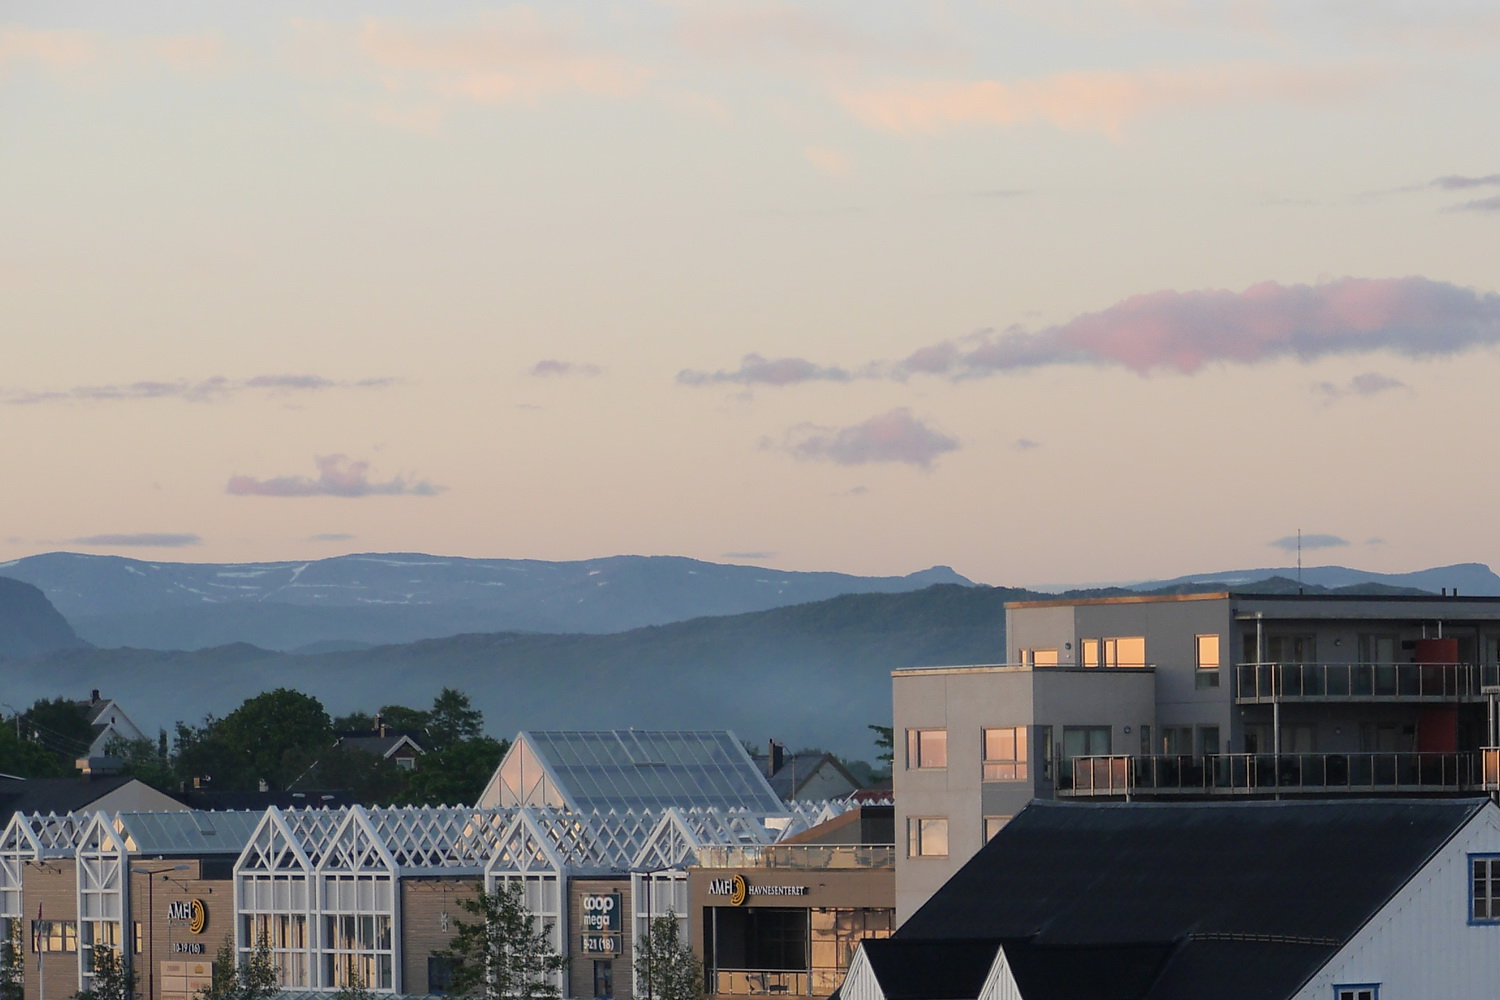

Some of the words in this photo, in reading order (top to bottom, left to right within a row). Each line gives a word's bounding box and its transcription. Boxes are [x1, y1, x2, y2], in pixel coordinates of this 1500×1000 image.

[708, 878, 733, 896] AMFI
[748, 885, 805, 896] HAVNESENTERET
[168, 901, 192, 919] AMFI
[583, 896, 614, 914] coop
[583, 914, 610, 930] mega
